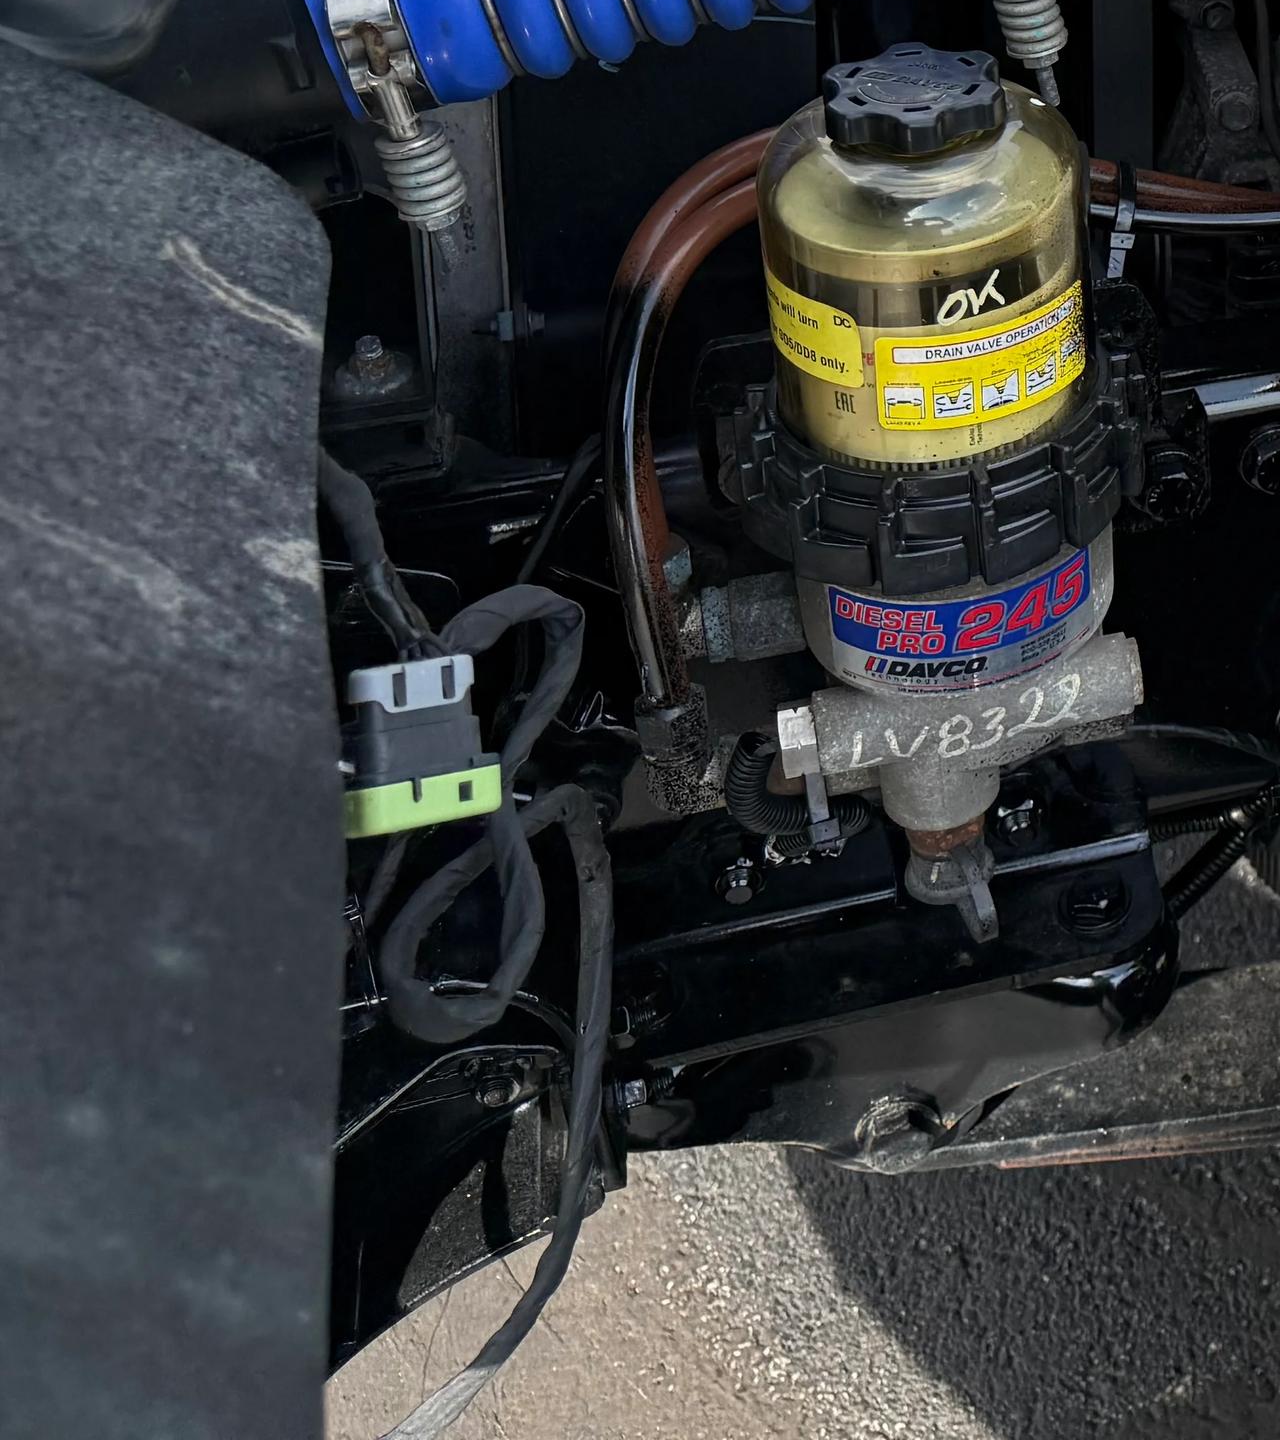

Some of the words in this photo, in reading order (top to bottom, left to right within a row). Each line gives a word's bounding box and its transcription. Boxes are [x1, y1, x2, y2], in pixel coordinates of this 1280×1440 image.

[937, 269, 1005, 326] OK
[798, 312, 819, 330] turn
[925, 346, 963, 360] DRAIN
[966, 336, 1002, 354] VALVE
[820, 355, 849, 373] only.
[835, 595, 945, 633] DIESEL
[952, 554, 1086, 653] 245
[876, 632, 946, 655] PRO
[887, 656, 985, 678] DAVCO
